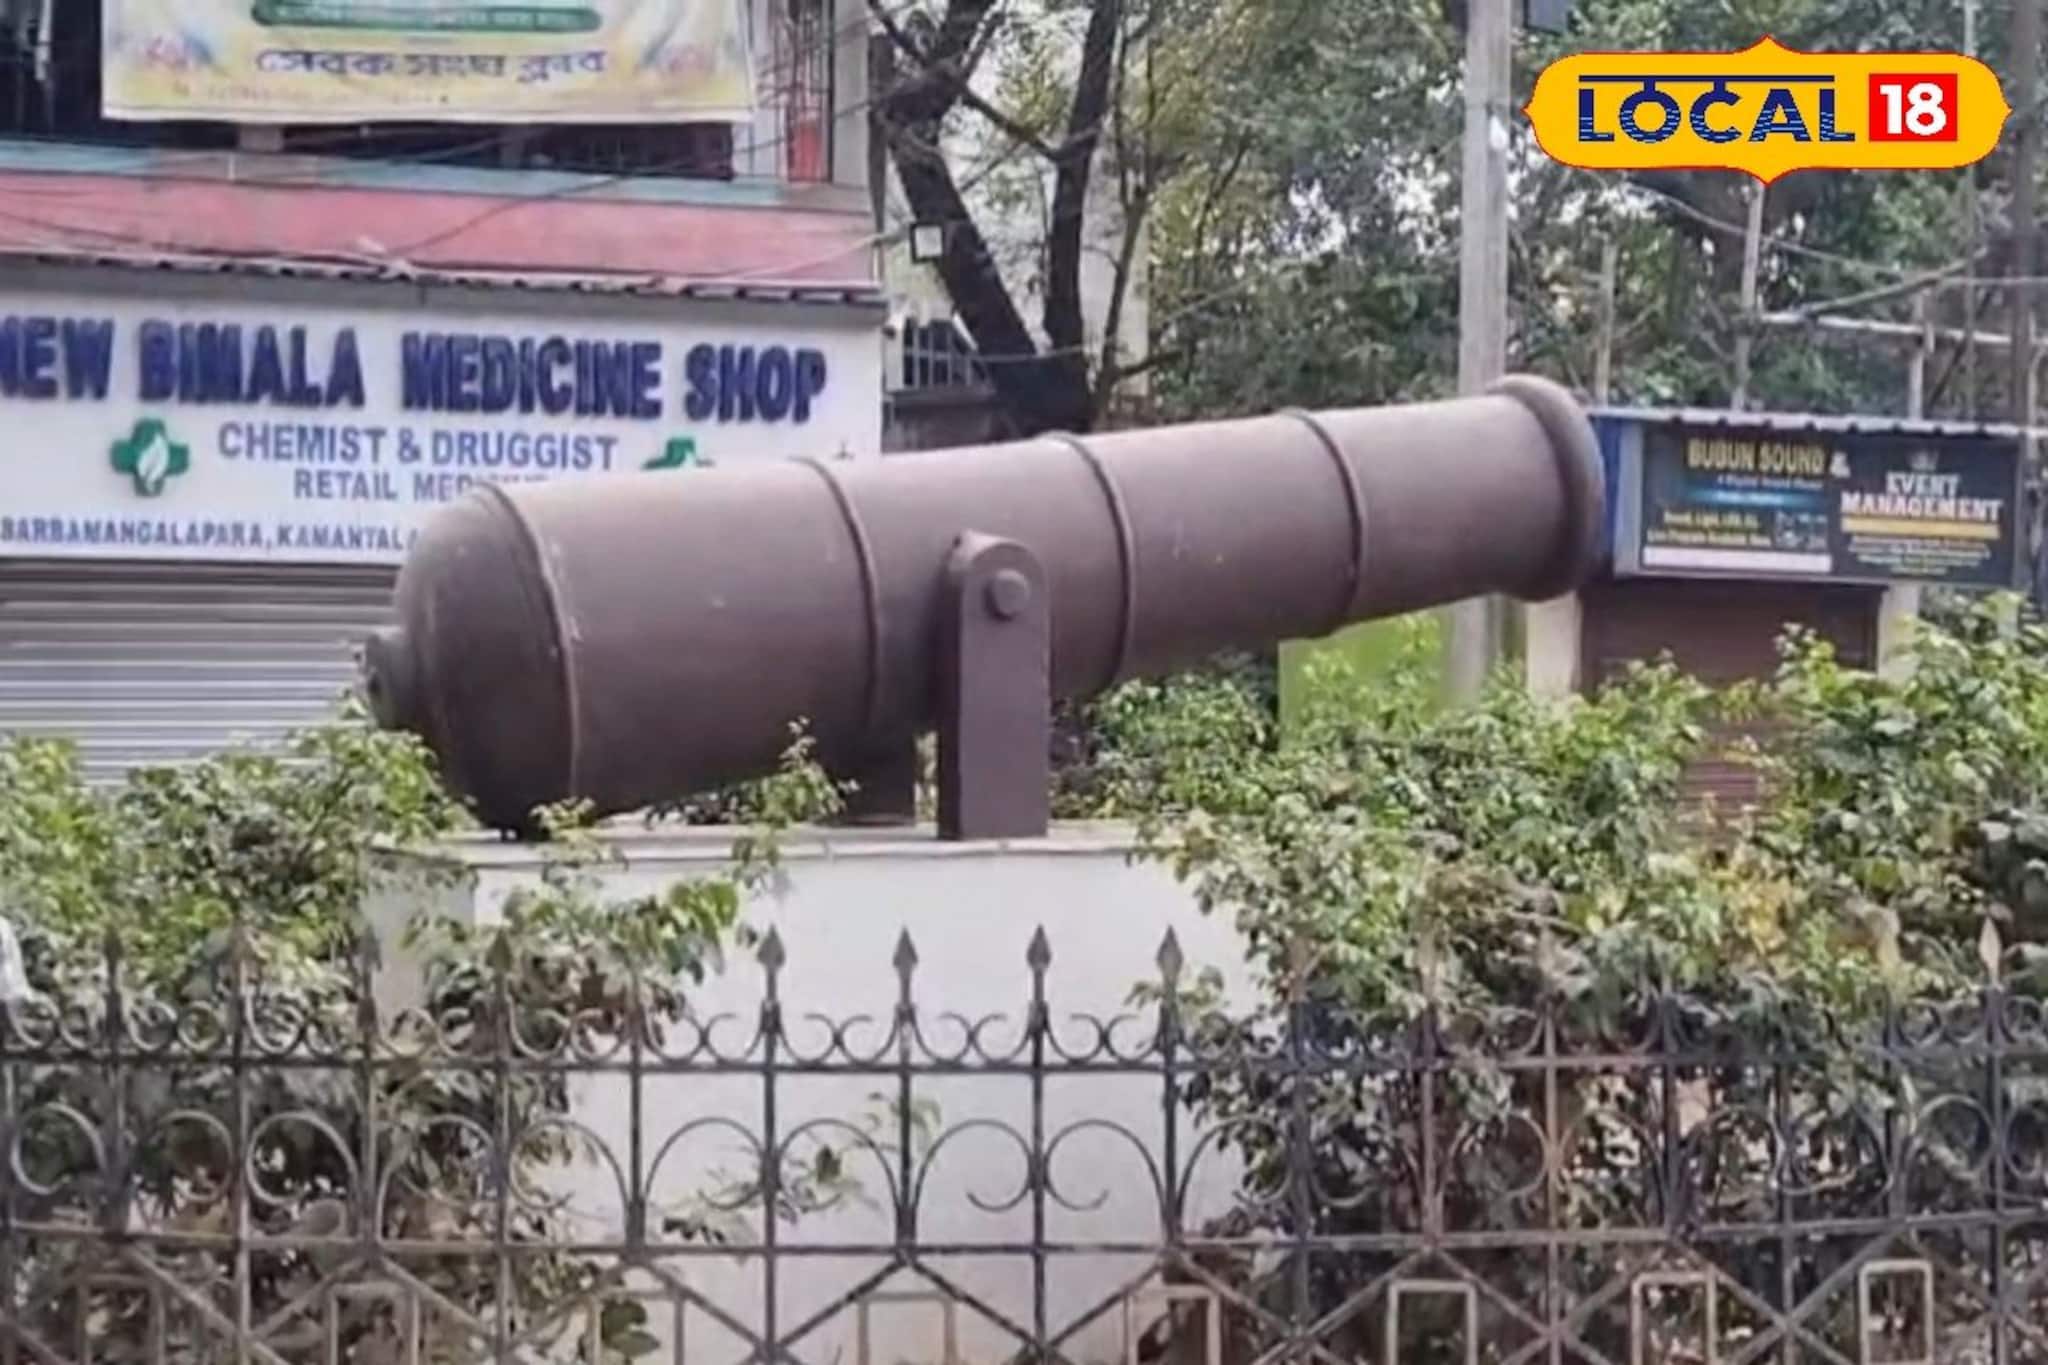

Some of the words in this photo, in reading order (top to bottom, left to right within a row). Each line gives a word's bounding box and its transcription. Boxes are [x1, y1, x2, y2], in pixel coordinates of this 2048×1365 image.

[138, 319, 365, 408] BIMALA
[401, 331, 662, 420] MEDICINE
[684, 342, 827, 424] SHOP
[217, 421, 387, 464] CHEMIST
[397, 427, 422, 465] &
[431, 430, 619, 470] DRUGGIST
[1757, 442, 1825, 475] SOUND
[1828, 453, 1850, 478] &
[294, 470, 398, 500] RETAIL
[1885, 471, 1961, 496] EVENT
[1841, 490, 2003, 522] MANAGEMENT
